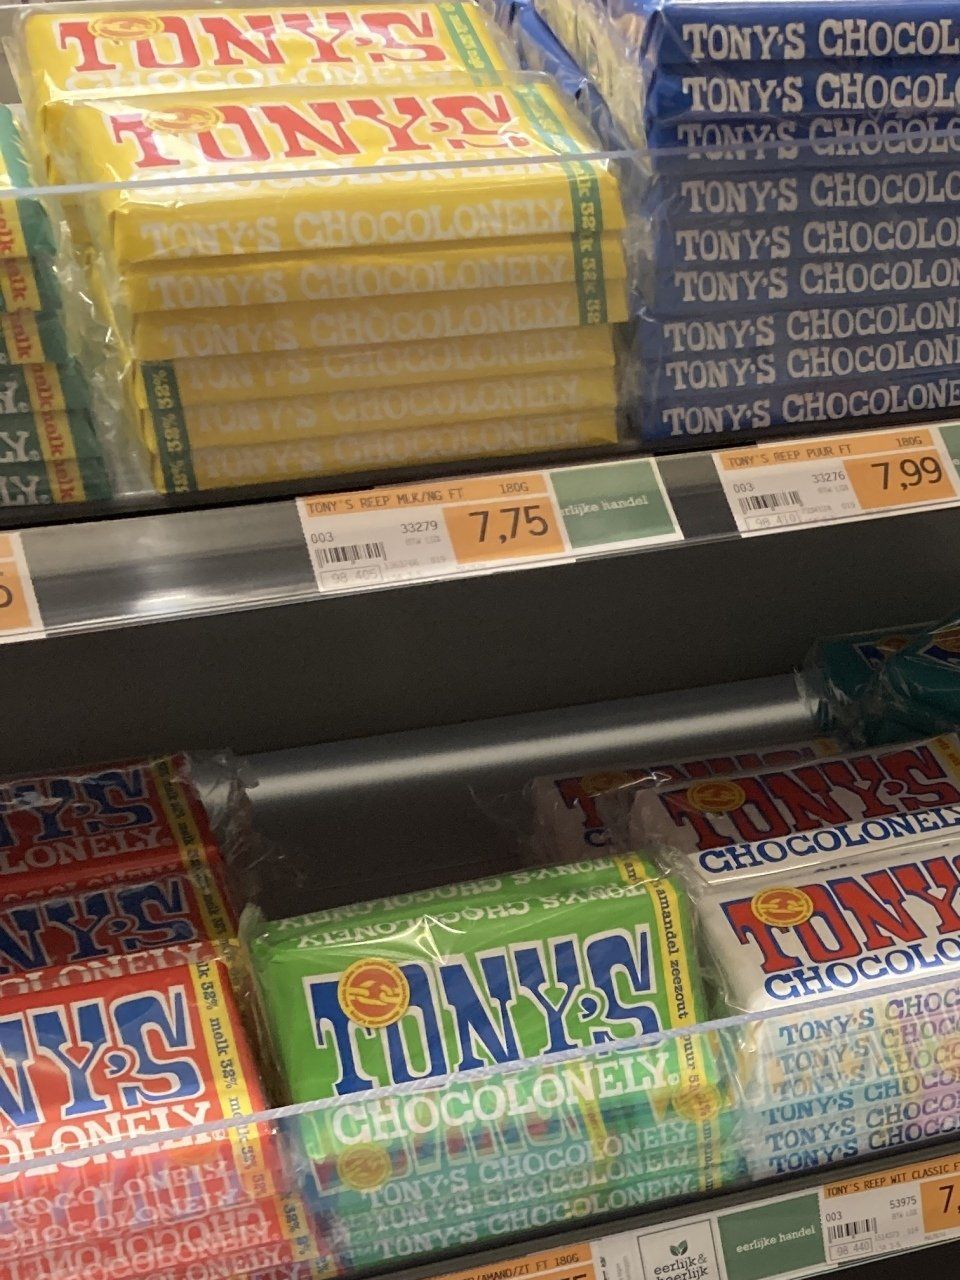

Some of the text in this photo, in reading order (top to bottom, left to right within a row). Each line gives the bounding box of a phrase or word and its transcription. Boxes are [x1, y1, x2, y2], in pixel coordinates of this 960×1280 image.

[58, 11, 447, 73] TONY'S
[682, 23, 805, 60] TONY'S
[110, 92, 531, 170] TONY'S
[676, 226, 790, 261] TONY'S
[729, 436, 923, 467] TONY'S PUUR 180G
[812, 471, 845, 484] 33276
[871, 456, 943, 490] 7,99
[307, 482, 529, 514] TONY'S REEP MLK/NG 180G
[602, 495, 648, 510] handel
[310, 532, 334, 544] 003
[401, 521, 438, 534] 33279
[468, 505, 549, 544] 7,75
[658, 889, 688, 1020] amandel zeezout
[303, 924, 666, 1096] TONY'S
[779, 1007, 875, 1047] TONY'S
[333, 1053, 674, 1146] CHOCOLONELY
[826, 1164, 949, 1197] TONY'S WIT CLASSIC
[889, 1195, 917, 1210] 53975
[736, 1226, 816, 1254] eerlijke handel
[653, 1256, 697, 1275] eerlijk
